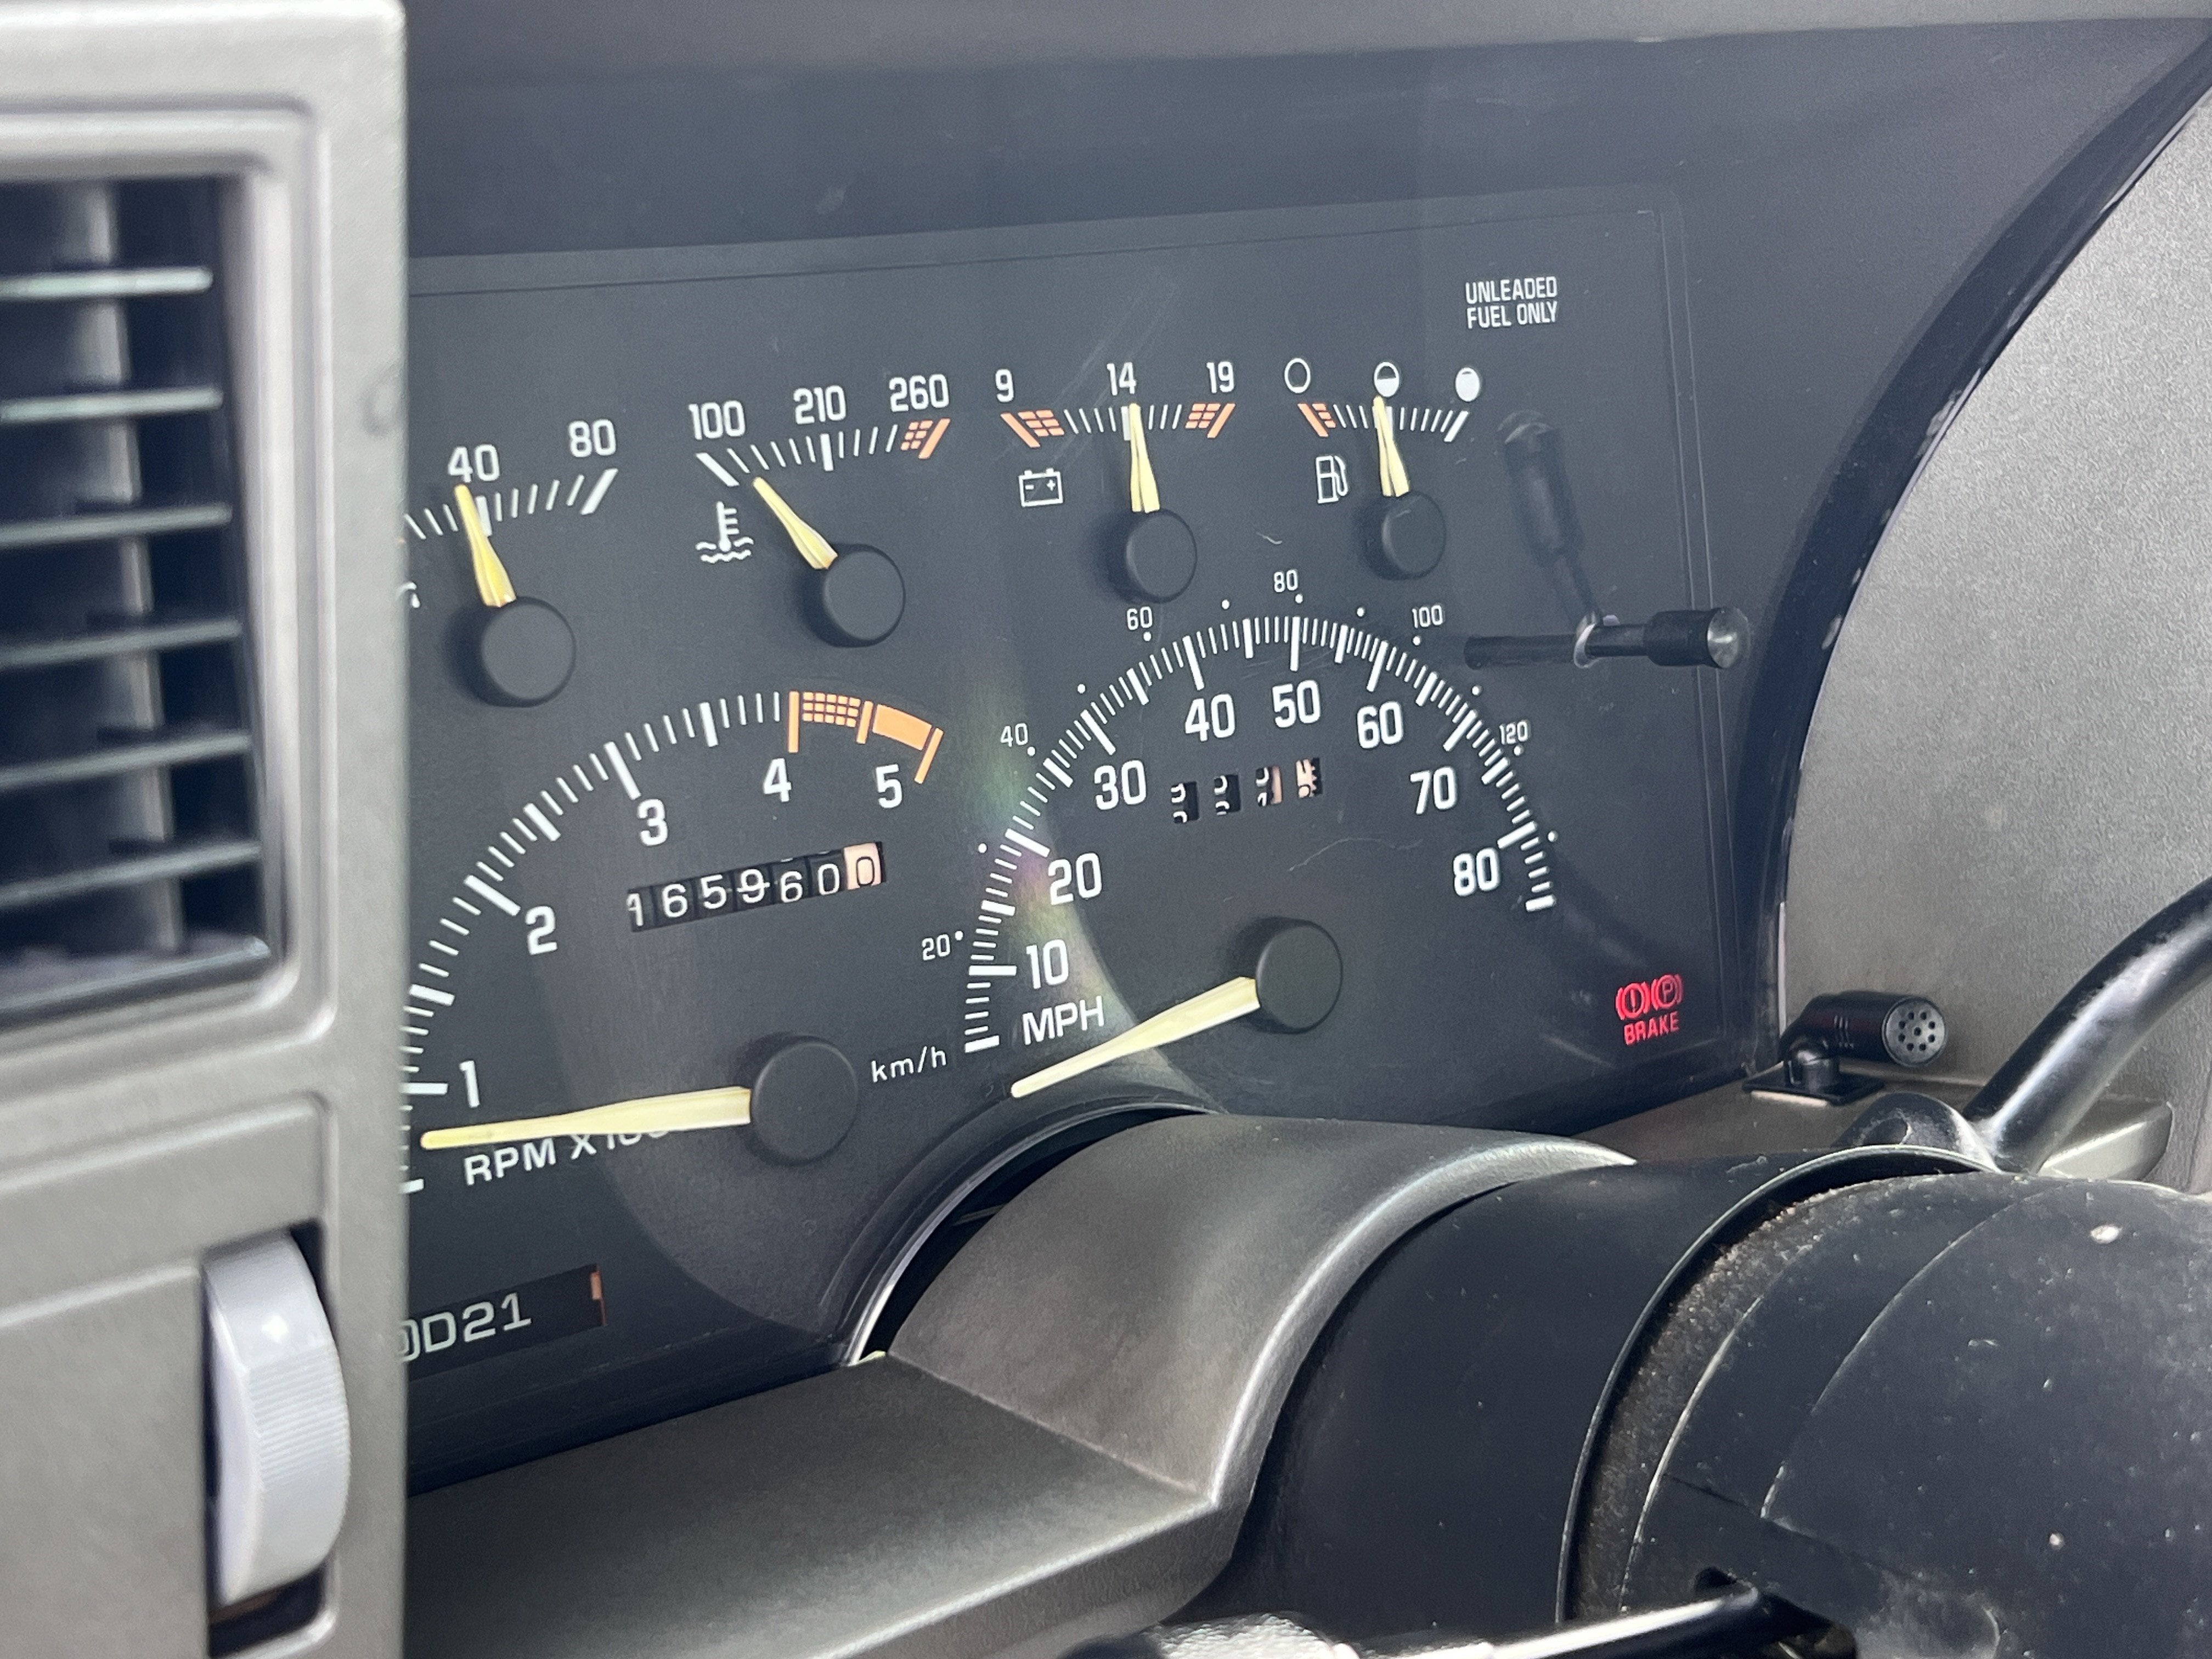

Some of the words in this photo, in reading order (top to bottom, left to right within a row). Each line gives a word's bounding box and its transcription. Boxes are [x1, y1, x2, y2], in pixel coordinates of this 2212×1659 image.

[1465, 276, 1558, 304] UNLEADED
[1466, 305, 1512, 329] FUEL
[1516, 301, 1558, 325] ONLY
[889, 374, 949, 412] 260
[995, 369, 1014, 402] 9
[1107, 362, 1137, 396] 14
[1206, 361, 1234, 393] 19
[689, 400, 746, 440] 100
[793, 385, 846, 424] 210
[569, 420, 616, 458] 80
[448, 444, 500, 483] 40
[1274, 569, 1298, 592] 80
[1127, 606, 1153, 630] 60
[1412, 605, 1443, 628] 100
[1185, 693, 1235, 742] 40
[1272, 680, 1321, 727] 50
[1000, 723, 1028, 747] 40
[1357, 702, 1403, 748] 60
[1499, 721, 1528, 744] 120
[763, 758, 792, 802] 4
[875, 764, 902, 808] 5
[1094, 760, 1146, 810] 30
[1410, 766, 1457, 814] 70
[637, 799, 668, 846] 3
[1048, 853, 1102, 905] 20
[1453, 848, 1500, 896] 80
[526, 906, 557, 955] 2
[922, 934, 951, 961] 20
[1026, 939, 1069, 989] 10
[1023, 996, 1104, 1045] MPH
[1624, 1011, 1679, 1045] BRAKE
[871, 1046, 946, 1082] km/h
[460, 1060, 480, 1108] 1
[464, 1137, 556, 1186] RPM
